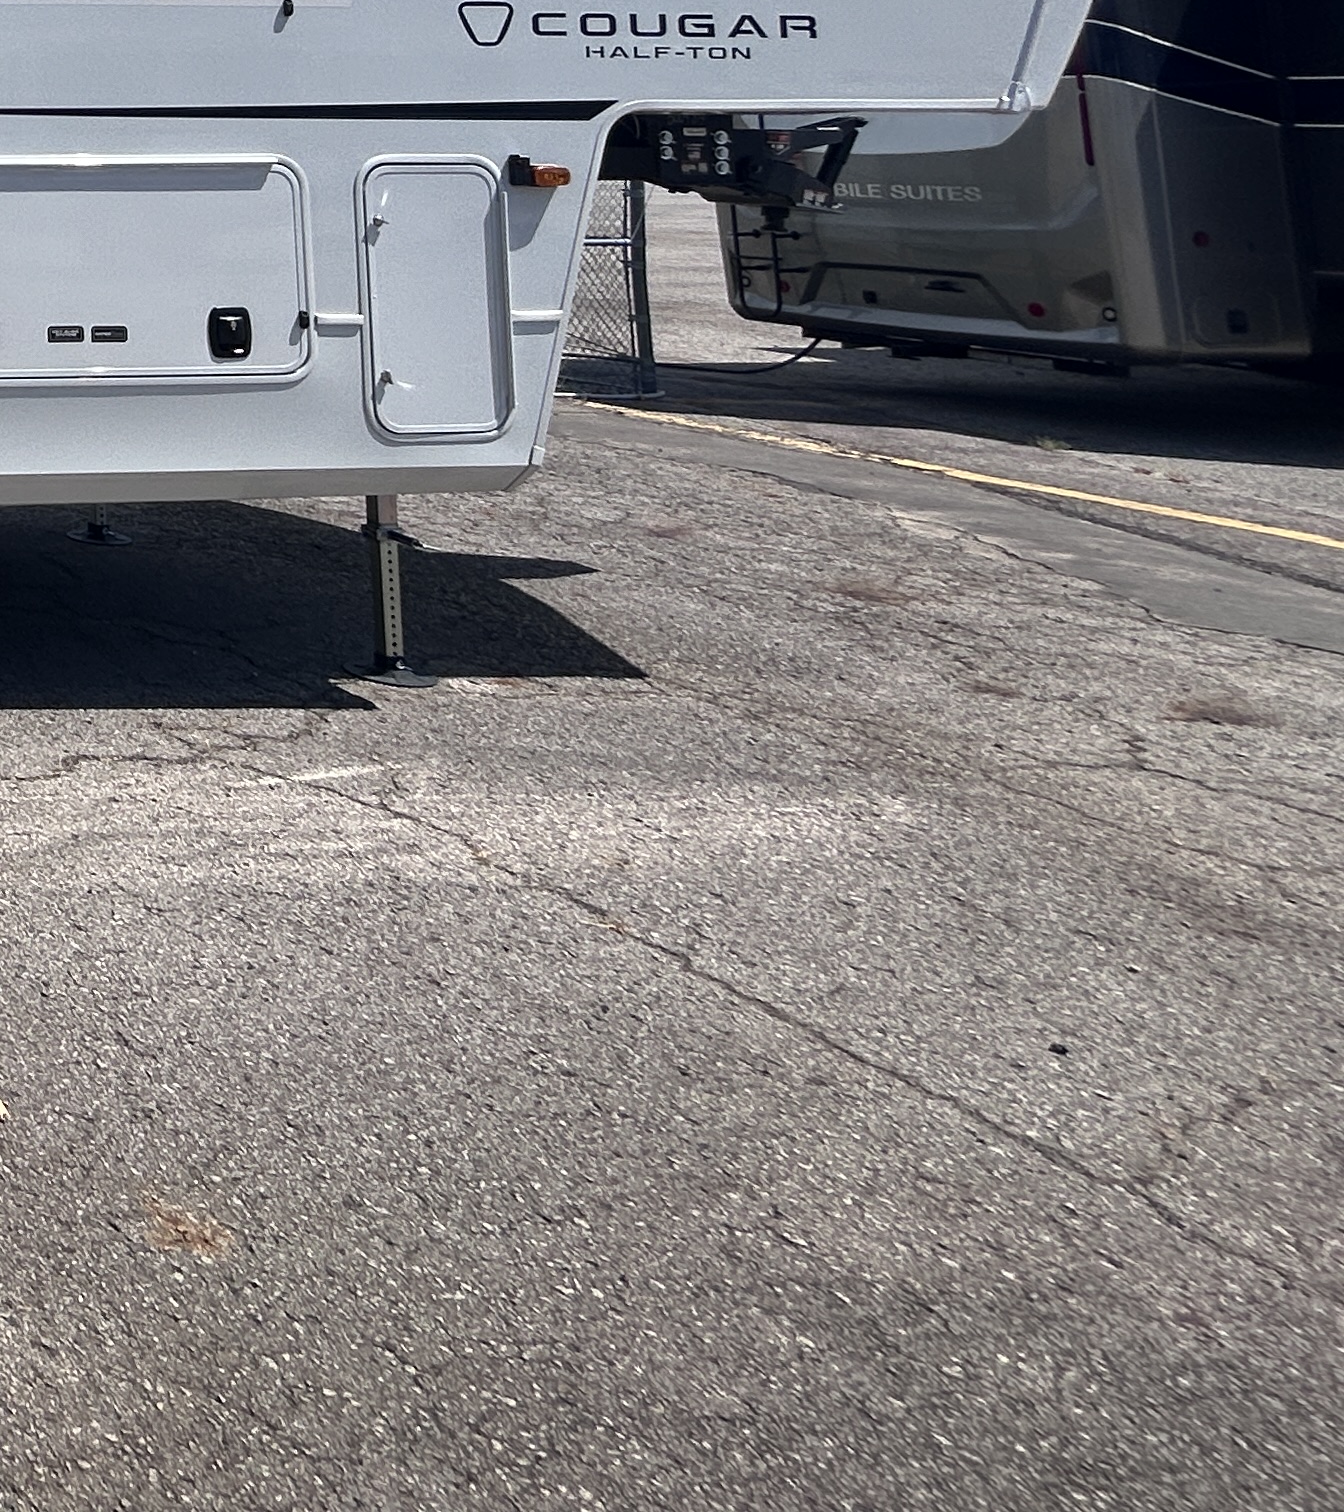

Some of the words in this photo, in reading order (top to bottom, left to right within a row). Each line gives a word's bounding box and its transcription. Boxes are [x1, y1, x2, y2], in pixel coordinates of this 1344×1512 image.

[531, 12, 818, 39] COUGAR
[584, 45, 752, 60] HALF-TON
[833, 182, 883, 199] BILE
[889, 184, 983, 202] SUITES
